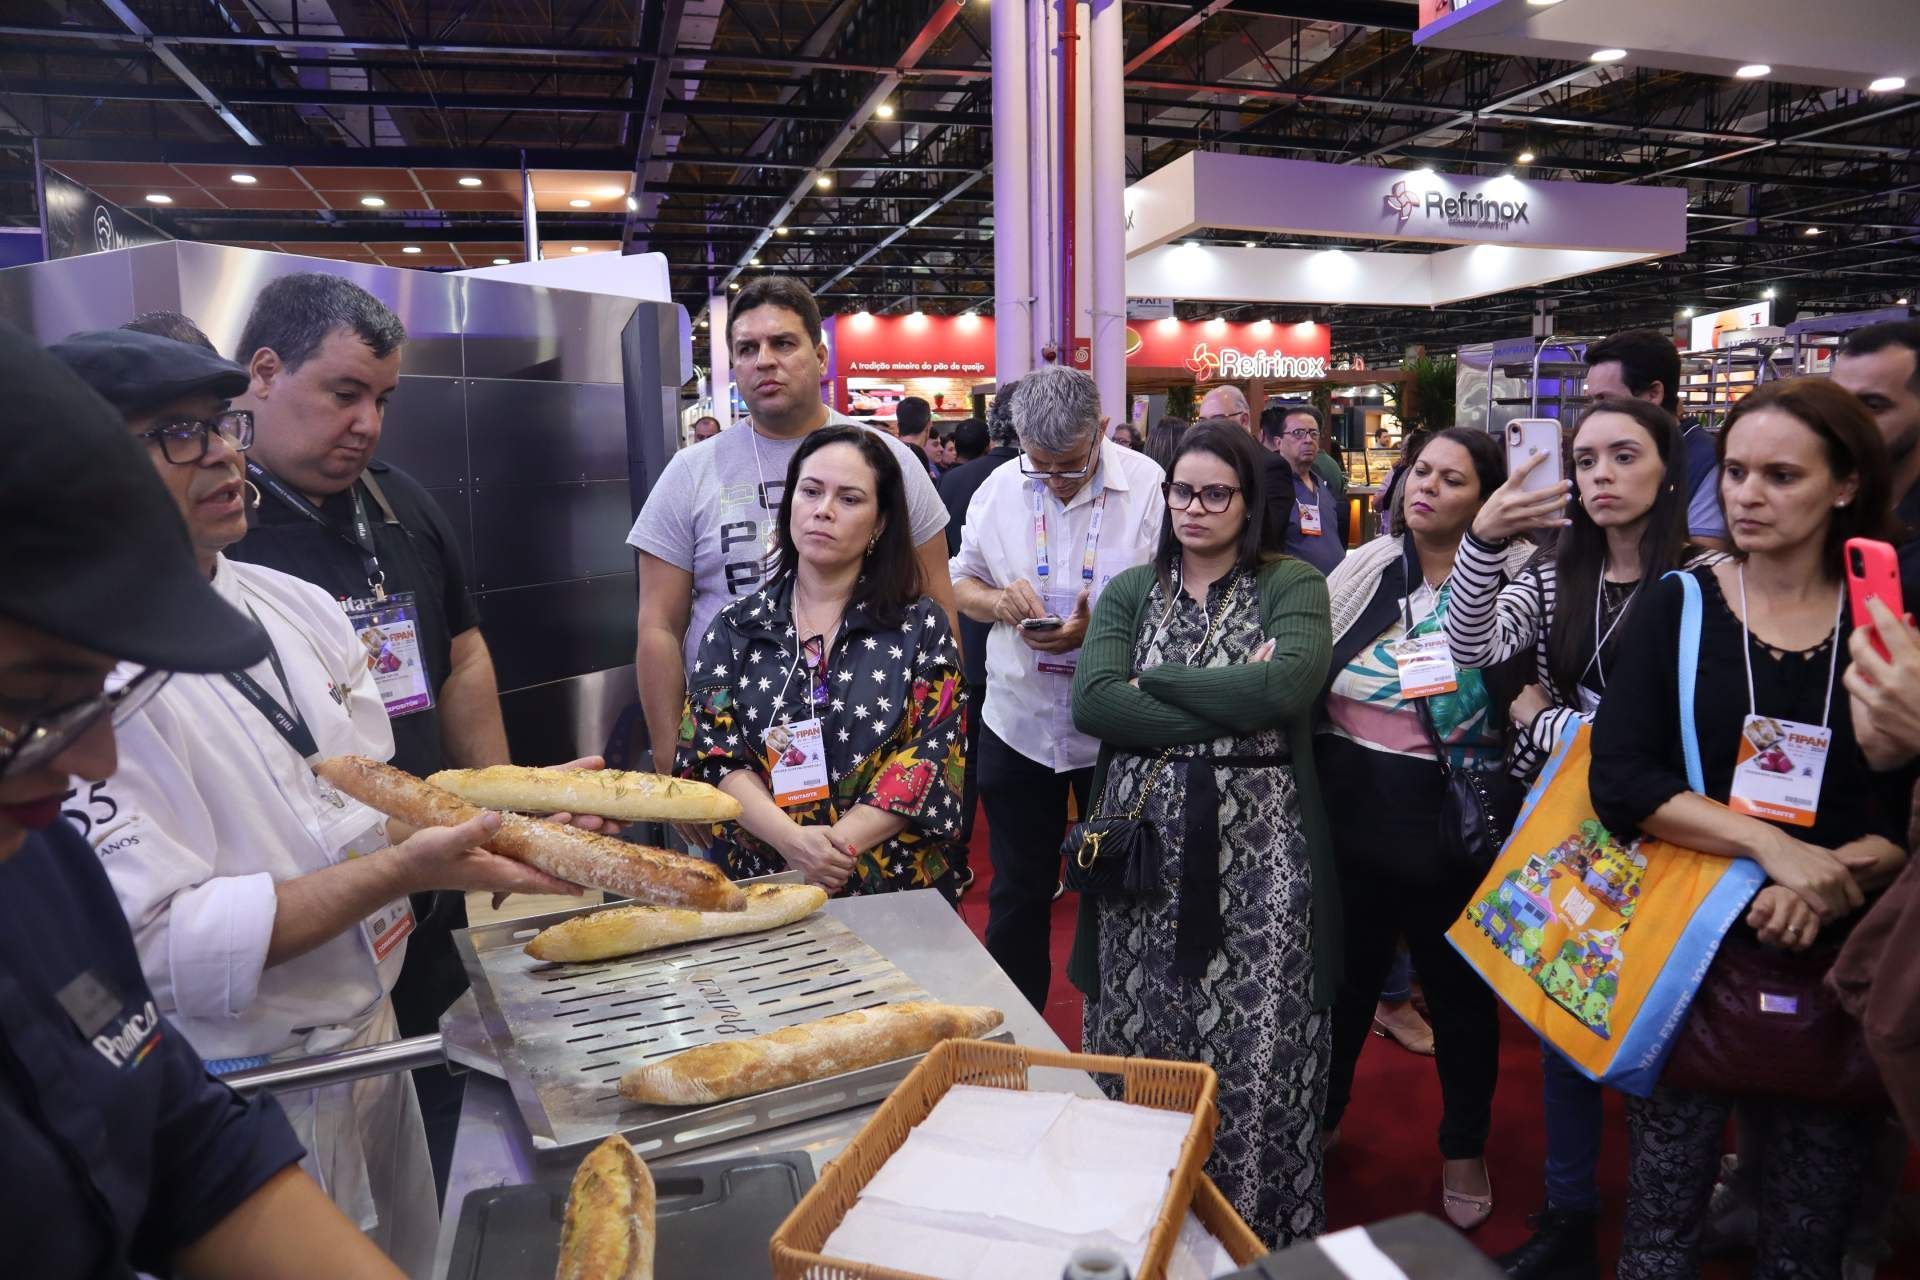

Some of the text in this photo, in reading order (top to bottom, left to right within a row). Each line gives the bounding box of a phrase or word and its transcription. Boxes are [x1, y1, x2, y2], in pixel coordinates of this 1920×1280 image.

[1425, 190, 1529, 224] Refrinox
[850, 361, 985, 372] A tradição mineira do pão de queijo
[1219, 348, 1327, 378] Refrinox
[389, 630, 415, 641] FIPAN
[795, 727, 820, 739] FIPAN
[1788, 733, 1828, 748] FIPAN
[101, 835, 141, 857] ANOS
[1659, 989, 1692, 1039] EXISTE
